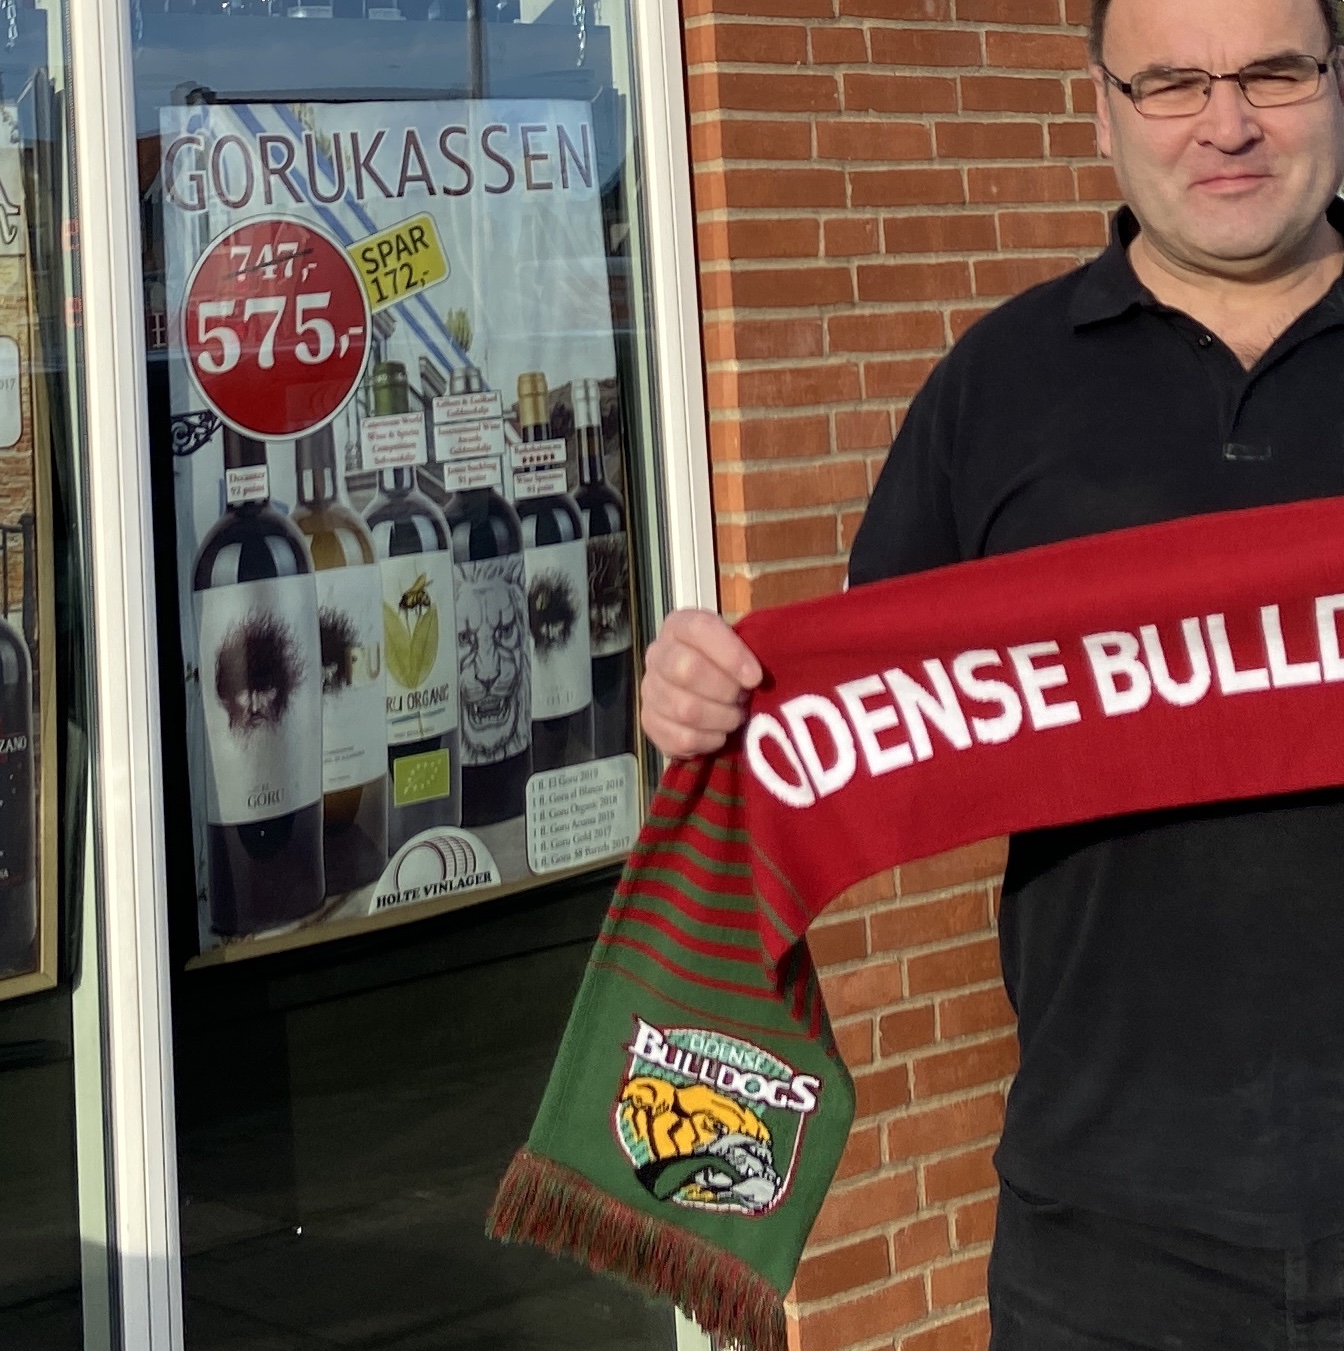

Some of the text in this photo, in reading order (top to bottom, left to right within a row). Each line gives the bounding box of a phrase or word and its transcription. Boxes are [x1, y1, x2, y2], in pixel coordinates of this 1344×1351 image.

[165, 123, 594, 211] GORUKASSEN
[361, 224, 430, 275] SPAR
[197, 291, 364, 375] 575,-
[745, 639, 1082, 810] ODENSE
[376, 871, 493, 909] HOLTE VINLAGER
[628, 1017, 821, 1113] BULLDOGS
